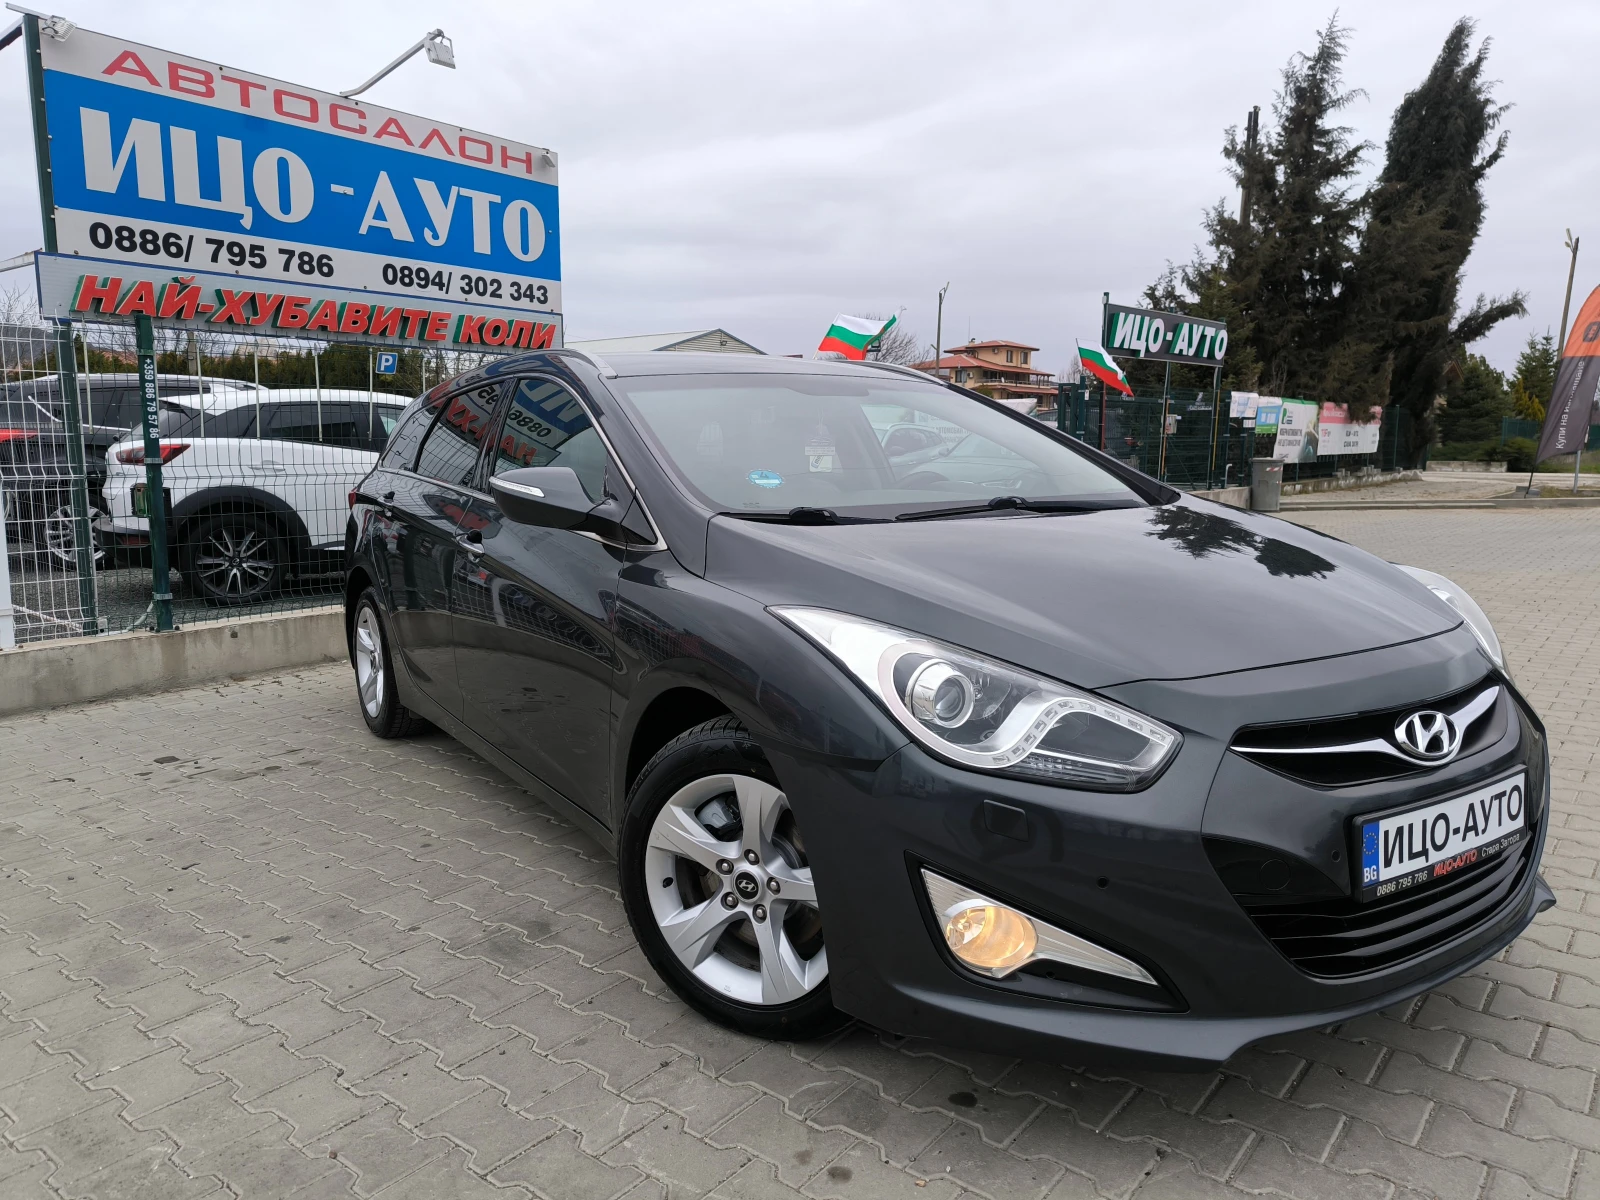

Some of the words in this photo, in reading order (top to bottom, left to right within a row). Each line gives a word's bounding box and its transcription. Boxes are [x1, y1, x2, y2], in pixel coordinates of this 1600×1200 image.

[102, 50, 533, 174] АВТОСАЛОН
[89, 221, 193, 263] 0886/
[206, 238, 267, 269] 795
[277, 249, 334, 279] 786
[382, 262, 453, 294] 0894/
[459, 273, 503, 299] 302
[509, 281, 549, 305] 343
[74, 275, 453, 341] НАЙ-ХУБАВИТЕ
[459, 313, 557, 349] КОЛИ
[1113, 311, 1229, 361] ИЦО-АУТО
[144, 358, 154, 380] +359
[381, 354, 393, 371] P
[145, 382, 155, 399] 886
[146, 401, 157, 412] 79
[148, 414, 158, 425] 57
[149, 427, 159, 439] 86
[1555, 424, 1566, 449] Купи
[1561, 413, 1569, 424] на
[1383, 784, 1523, 869] ИЦО-АУТО
[1363, 865, 1377, 883] BG
[1377, 882, 1396, 897] 0886
[1398, 877, 1412, 890] 795
[1414, 870, 1428, 884] 786
[1433, 848, 1478, 877] ИЦО-АУТО
[1481, 843, 1500, 857] Стара
[1500, 833, 1520, 848] Загора
